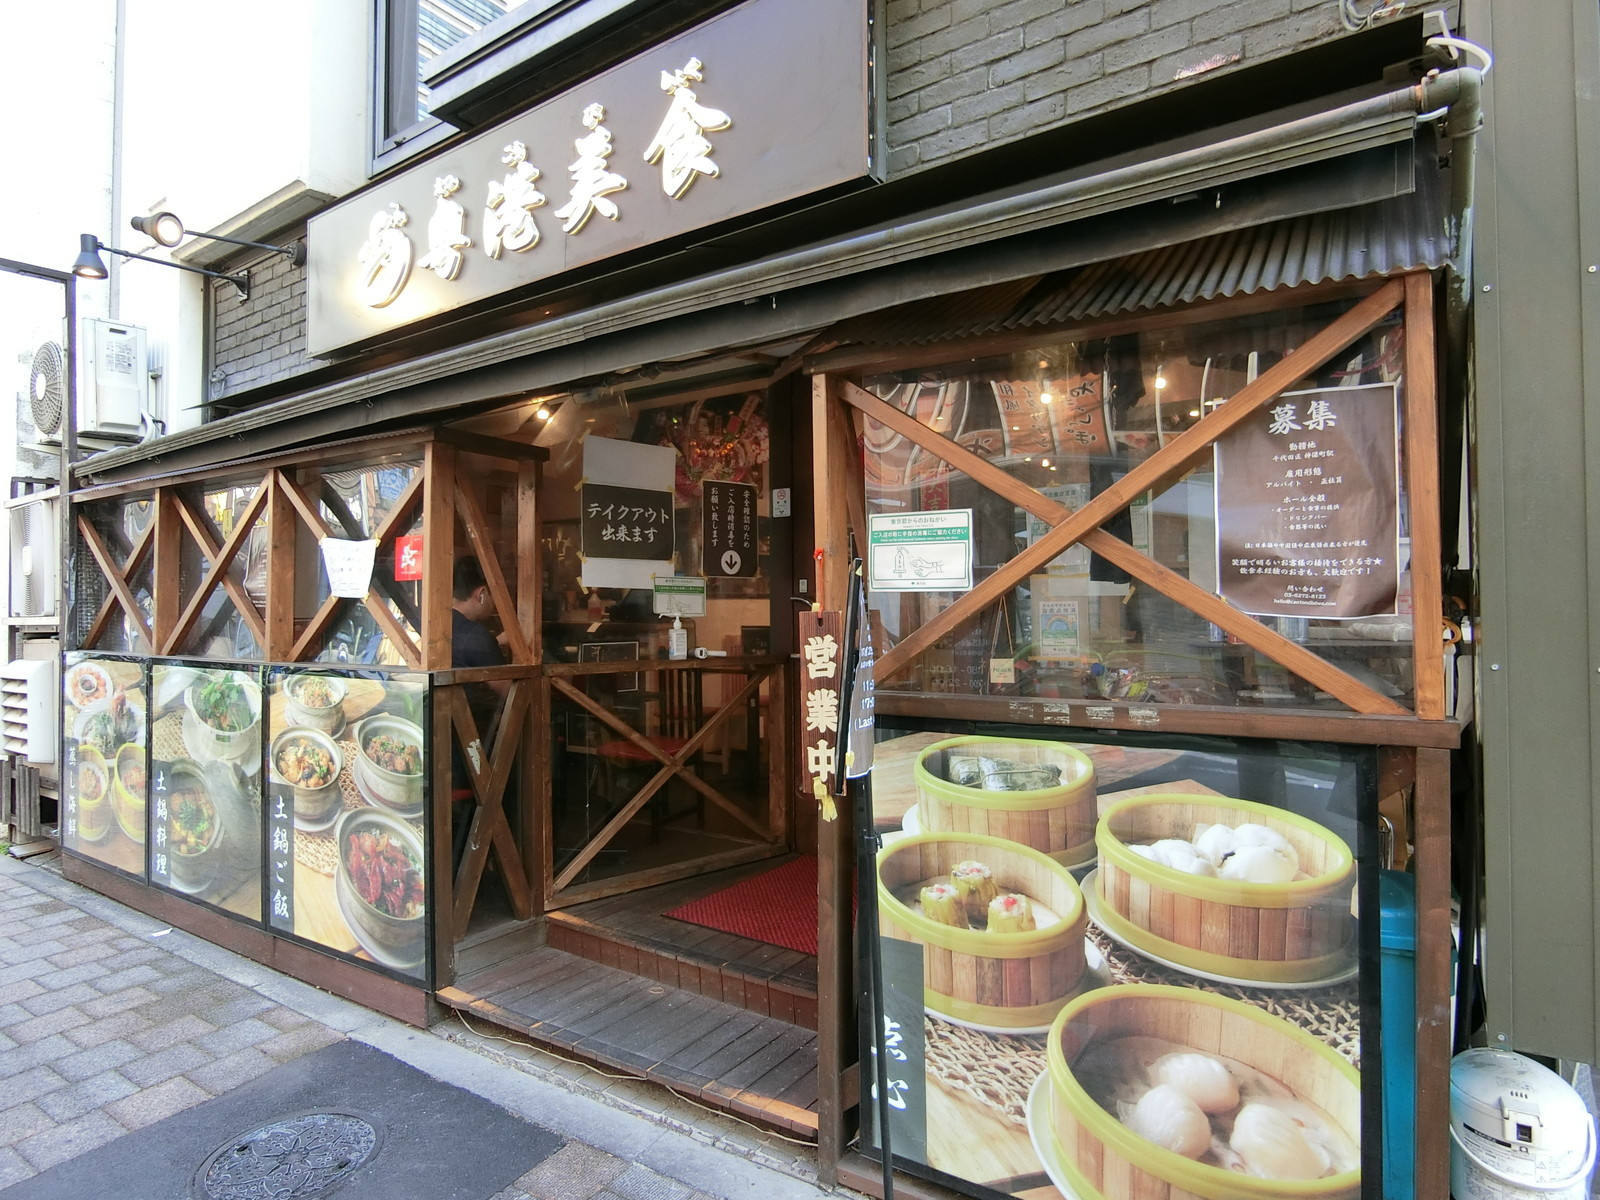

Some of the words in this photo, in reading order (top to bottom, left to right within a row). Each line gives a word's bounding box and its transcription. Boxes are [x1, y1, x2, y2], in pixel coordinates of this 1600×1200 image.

[1268, 400, 1337, 435] 募集
[1272, 453, 1302, 462] 千代田区
[1304, 450, 1334, 460] 神保町駅
[1289, 440, 1317, 452] 勤務地
[1266, 480, 1302, 488] アルバイト
[1320, 475, 1343, 486] 正社員
[1285, 466, 1322, 478] 雇用形態
[1283, 493, 1326, 504] ホール全般
[587, 503, 671, 525] テイクアウト
[711, 487, 719, 547] お願い致します
[727, 488, 736, 548] ご入店時消毒を
[743, 490, 751, 549] 安全確認のため
[890, 516, 947, 525] 東京都からのおねがい
[601, 525, 658, 543] 出来ます
[1287, 584, 1324, 593] 問い合わせ
[804, 634, 838, 782] 営業中
[155, 770, 168, 876] 土鍋料理
[273, 795, 290, 919] 土鍋ご飯
